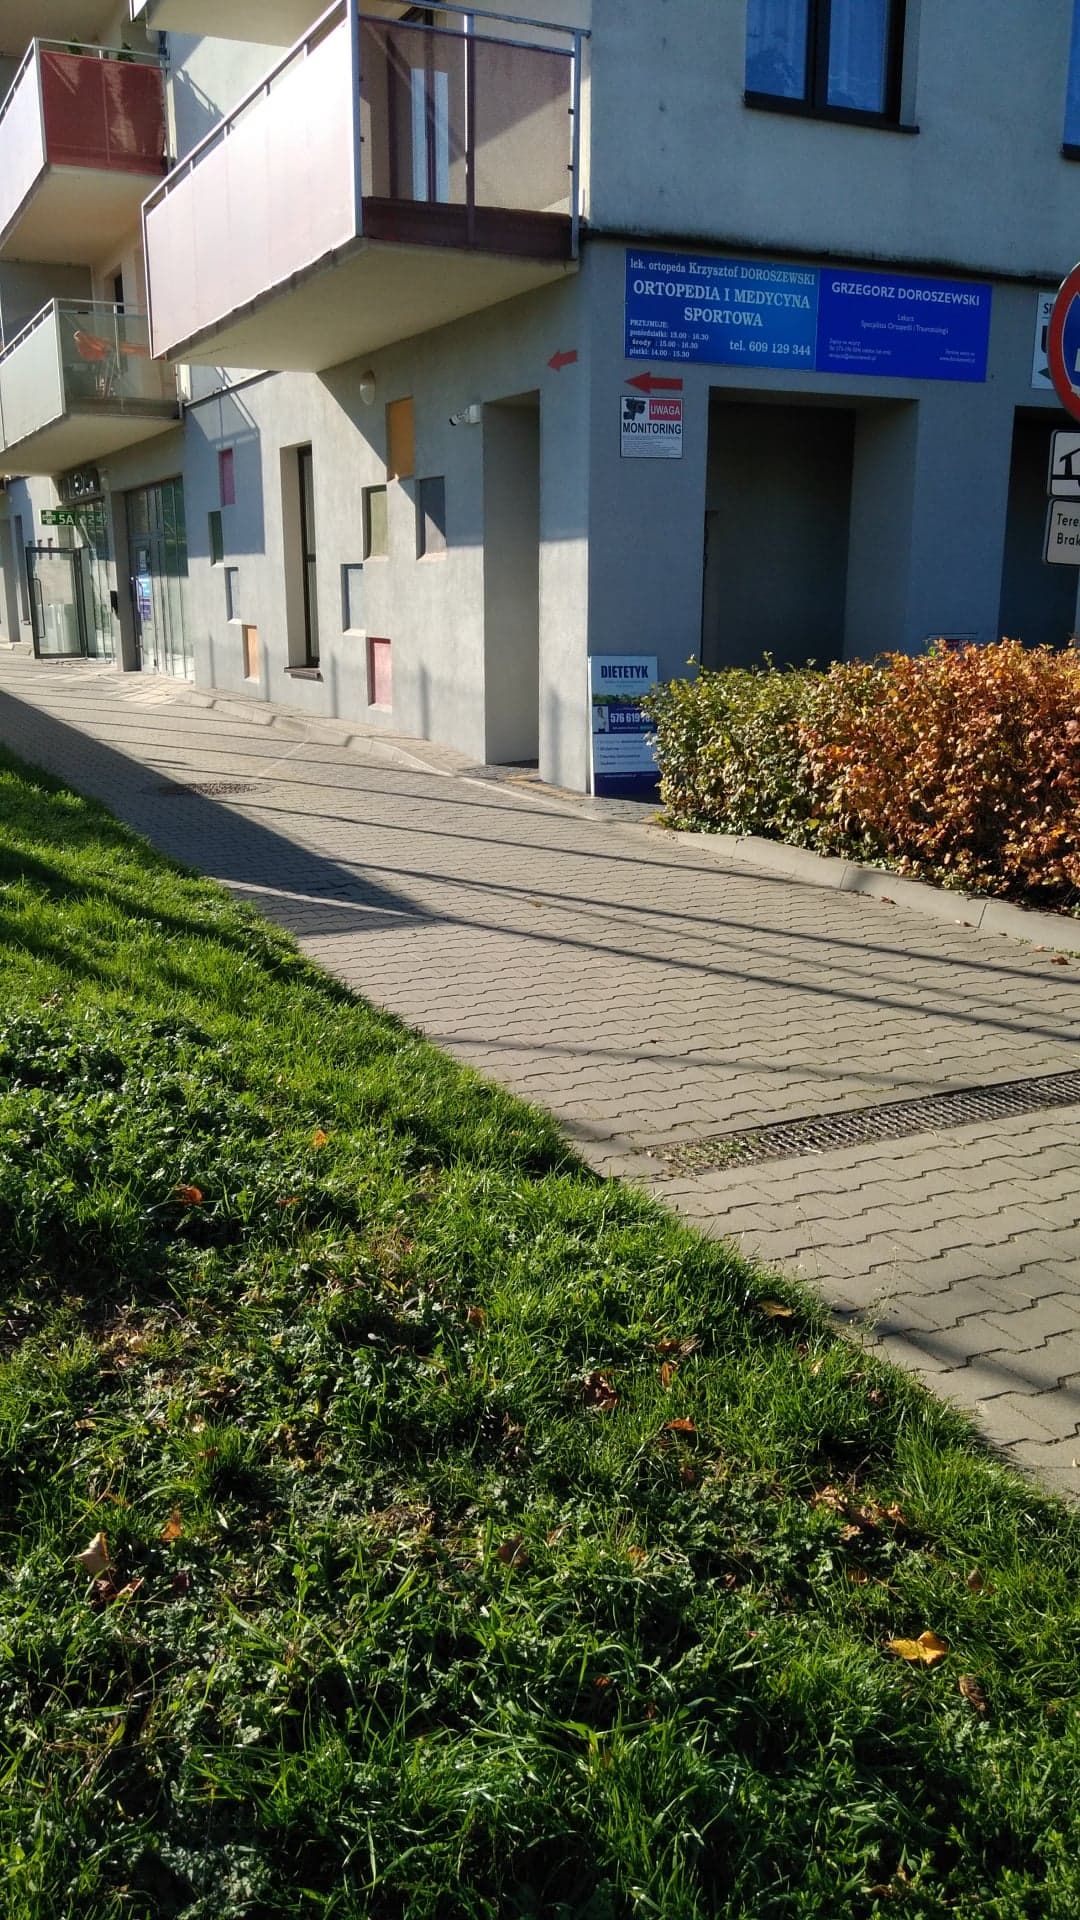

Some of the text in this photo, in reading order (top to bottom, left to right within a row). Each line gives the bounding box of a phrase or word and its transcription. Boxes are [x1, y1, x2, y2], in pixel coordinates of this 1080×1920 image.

[630, 258, 815, 286] lek. ortopeda Krzysztof DOROSZEWSKI
[633, 279, 811, 309] ORTOPEDIA I MEDYCYNA
[831, 281, 980, 307] GRZEGORZ DOROSZEWSKI
[683, 306, 763, 327] SPORTOWA
[729, 340, 811, 356] tel. 609 129 344
[650, 404, 681, 416] UWAGA
[622, 422, 682, 435] MONITORING
[600, 665, 649, 679] DIETETYK
[610, 712, 625, 724] 576
[625, 712, 640, 724] 619
